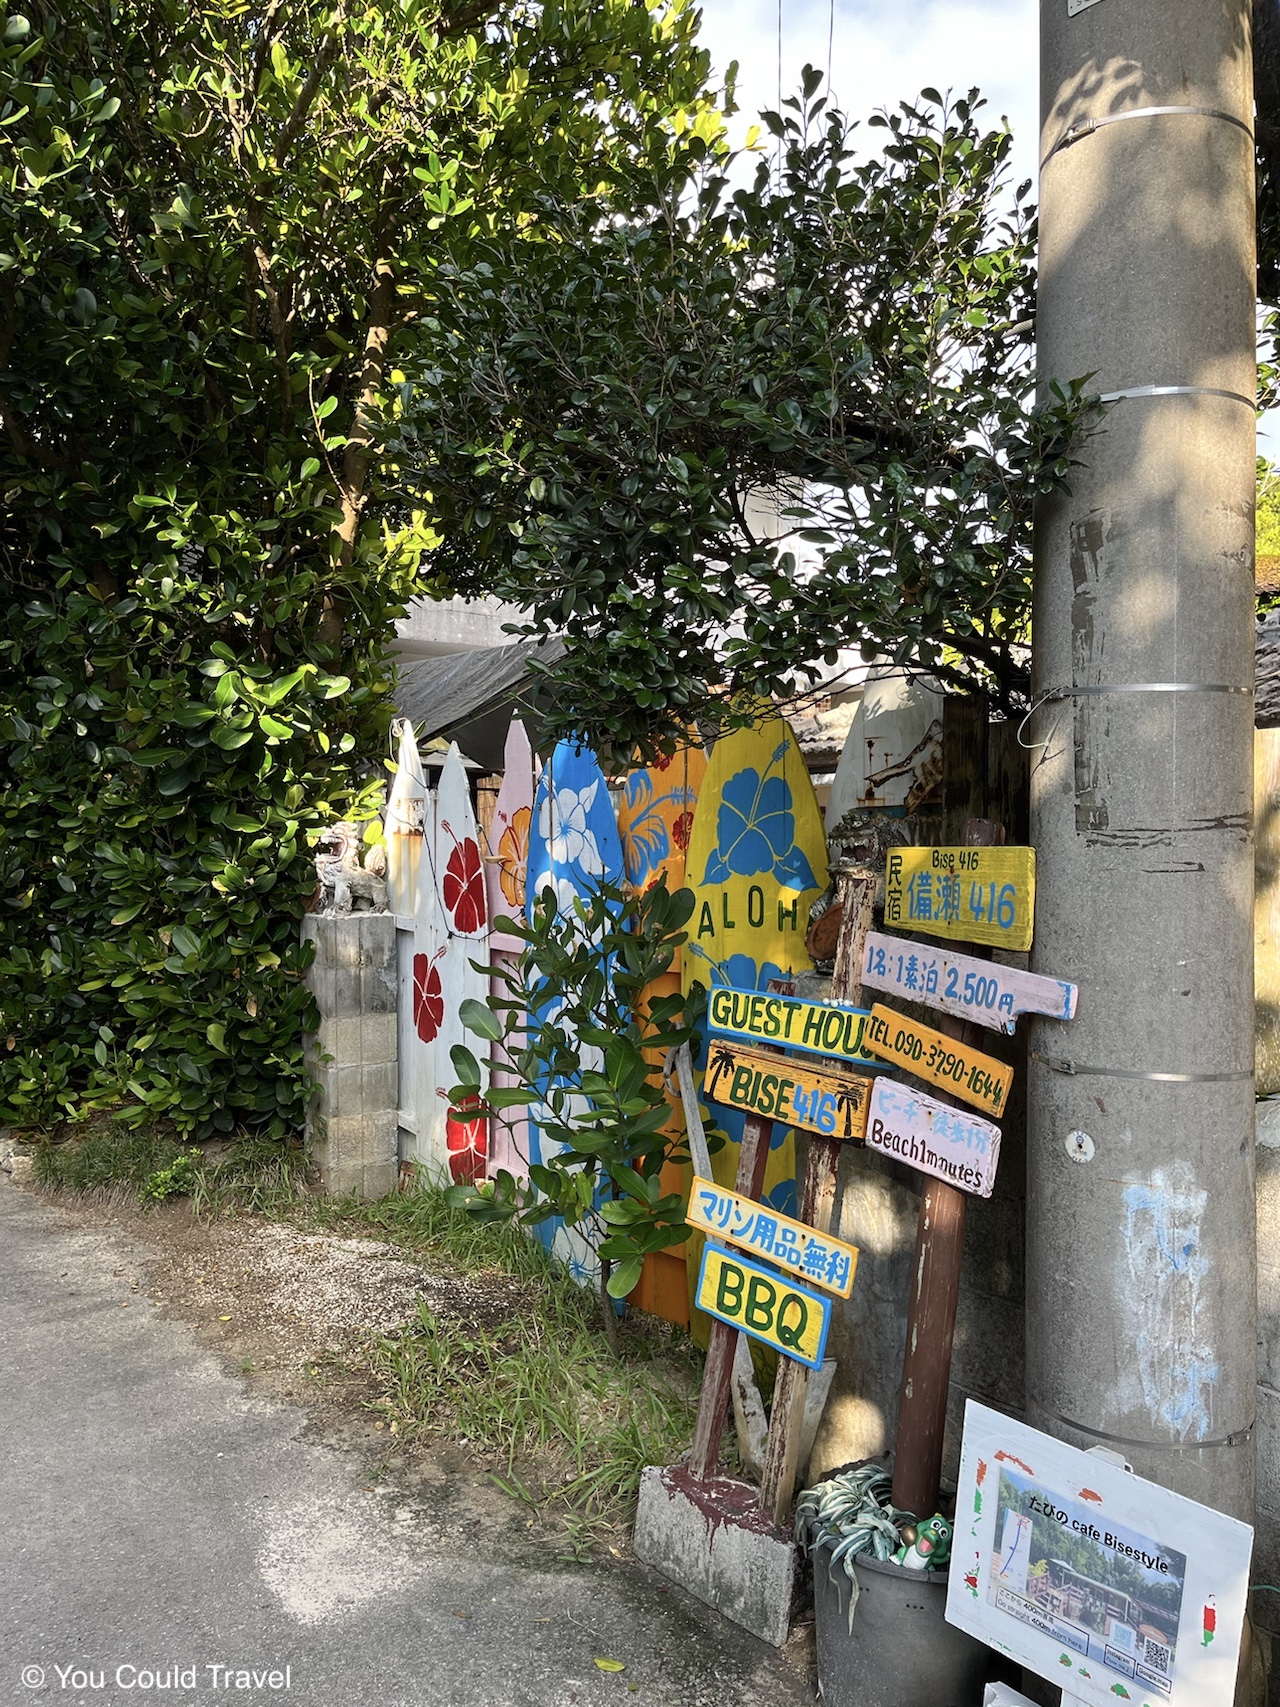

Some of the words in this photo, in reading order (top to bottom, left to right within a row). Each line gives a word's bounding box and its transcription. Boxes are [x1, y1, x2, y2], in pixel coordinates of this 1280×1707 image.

[932, 850, 954, 869] Bise
[959, 851, 979, 870] 416
[697, 885, 814, 940] ALOH
[887, 855, 902, 921] 民宿
[969, 880, 1016, 929] 416
[712, 990, 802, 1038] GUEST
[878, 1090, 918, 1122] ビーチ
[716, 1261, 808, 1352] BBQ
[1028, 1495, 1069, 1525] たびの
[1072, 1519, 1101, 1541] cafe
[1104, 1531, 1169, 1573] Bisestyle
[1031, 1618, 1051, 1632] 400m
